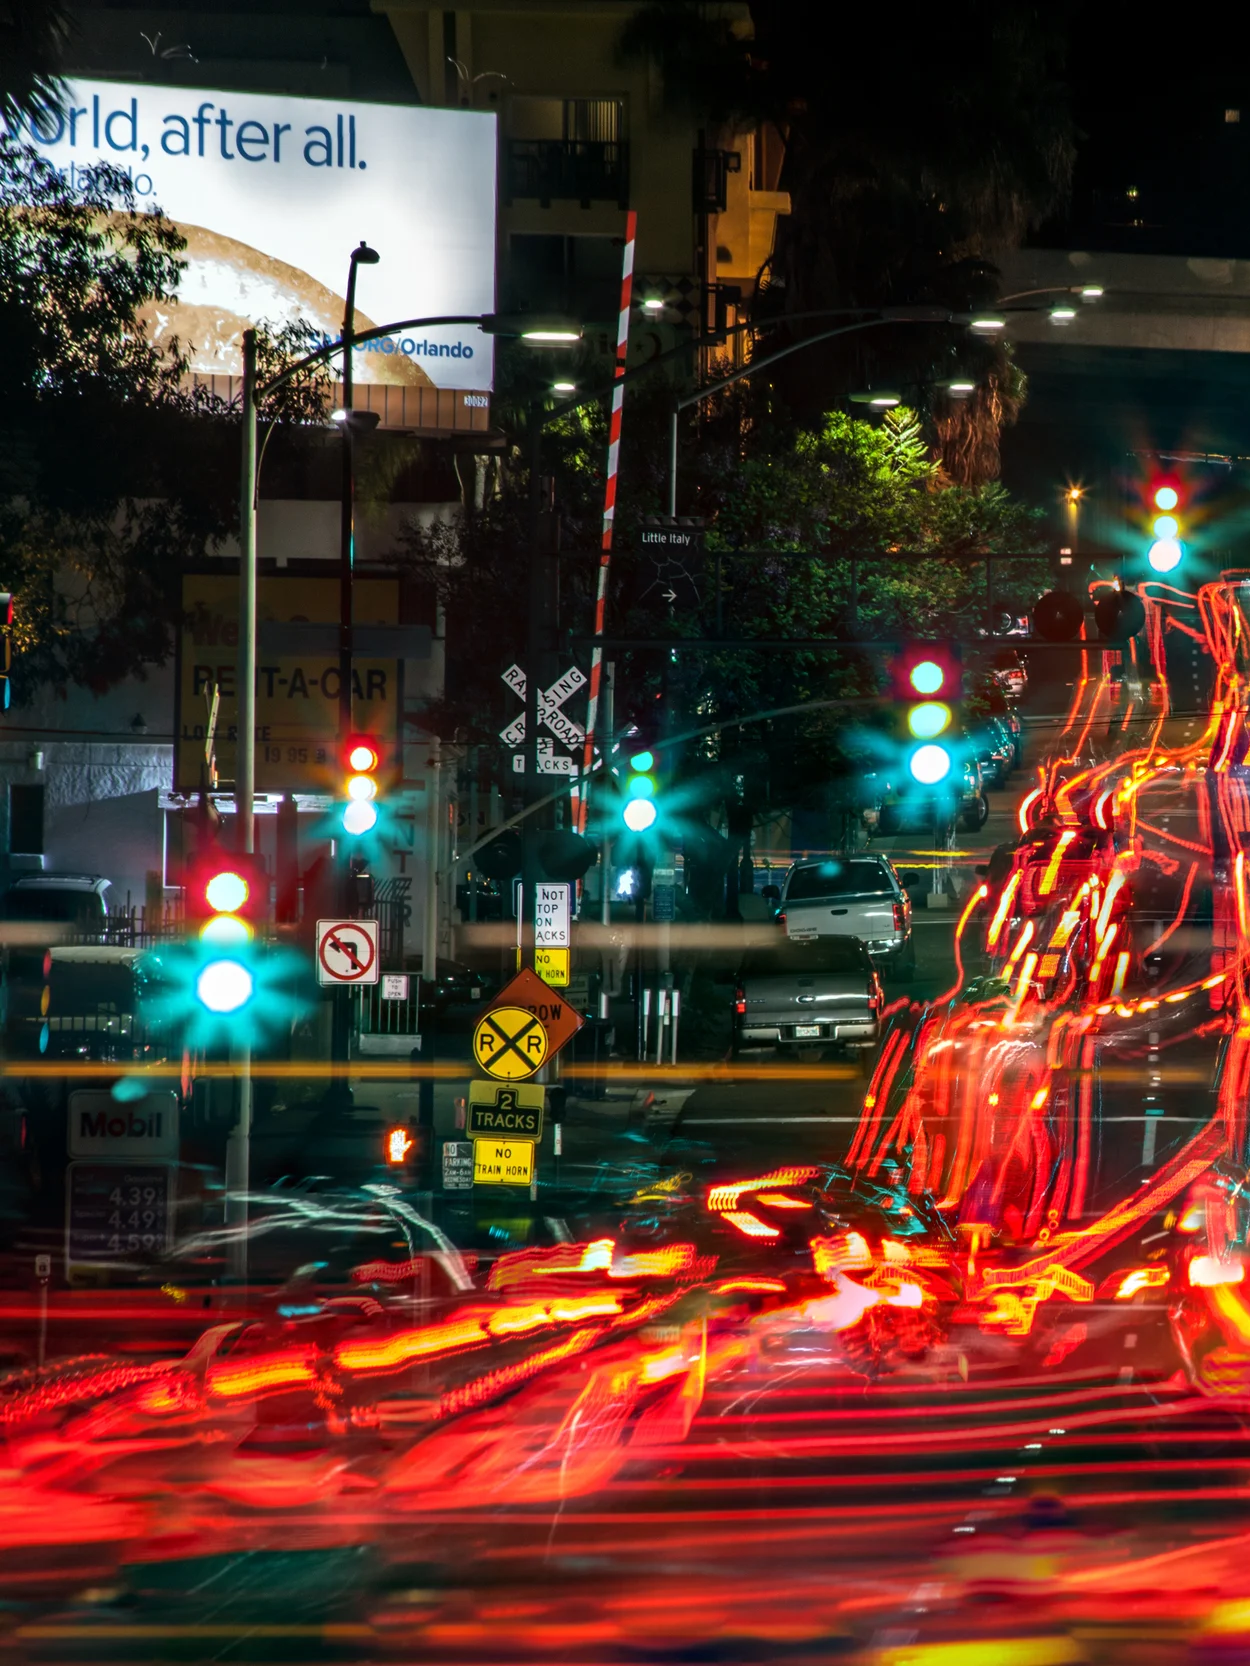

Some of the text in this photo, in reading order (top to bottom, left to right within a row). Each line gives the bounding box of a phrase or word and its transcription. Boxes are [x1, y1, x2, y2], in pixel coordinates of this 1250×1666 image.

[0, 94, 367, 169] orld, after all.
[642, 532, 690, 546] Little Italy
[193, 664, 387, 701] RET-A-CAR
[542, 890, 564, 901] NOT
[537, 904, 558, 914] TOP
[536, 918, 552, 927] ON
[536, 931, 566, 940] ACKS
[537, 955, 550, 964] NO
[546, 969, 565, 978] HORN
[501, 1093, 513, 1109] 2
[80, 1112, 162, 1137] Mobil
[475, 1111, 535, 1130] TRACKS
[495, 1148, 512, 1159] NO
[444, 1158, 472, 1167] PARKING
[477, 1163, 528, 1176] TRAIN HORN
[109, 1186, 156, 1206] 4.39
[108, 1209, 156, 1229] 4.49
